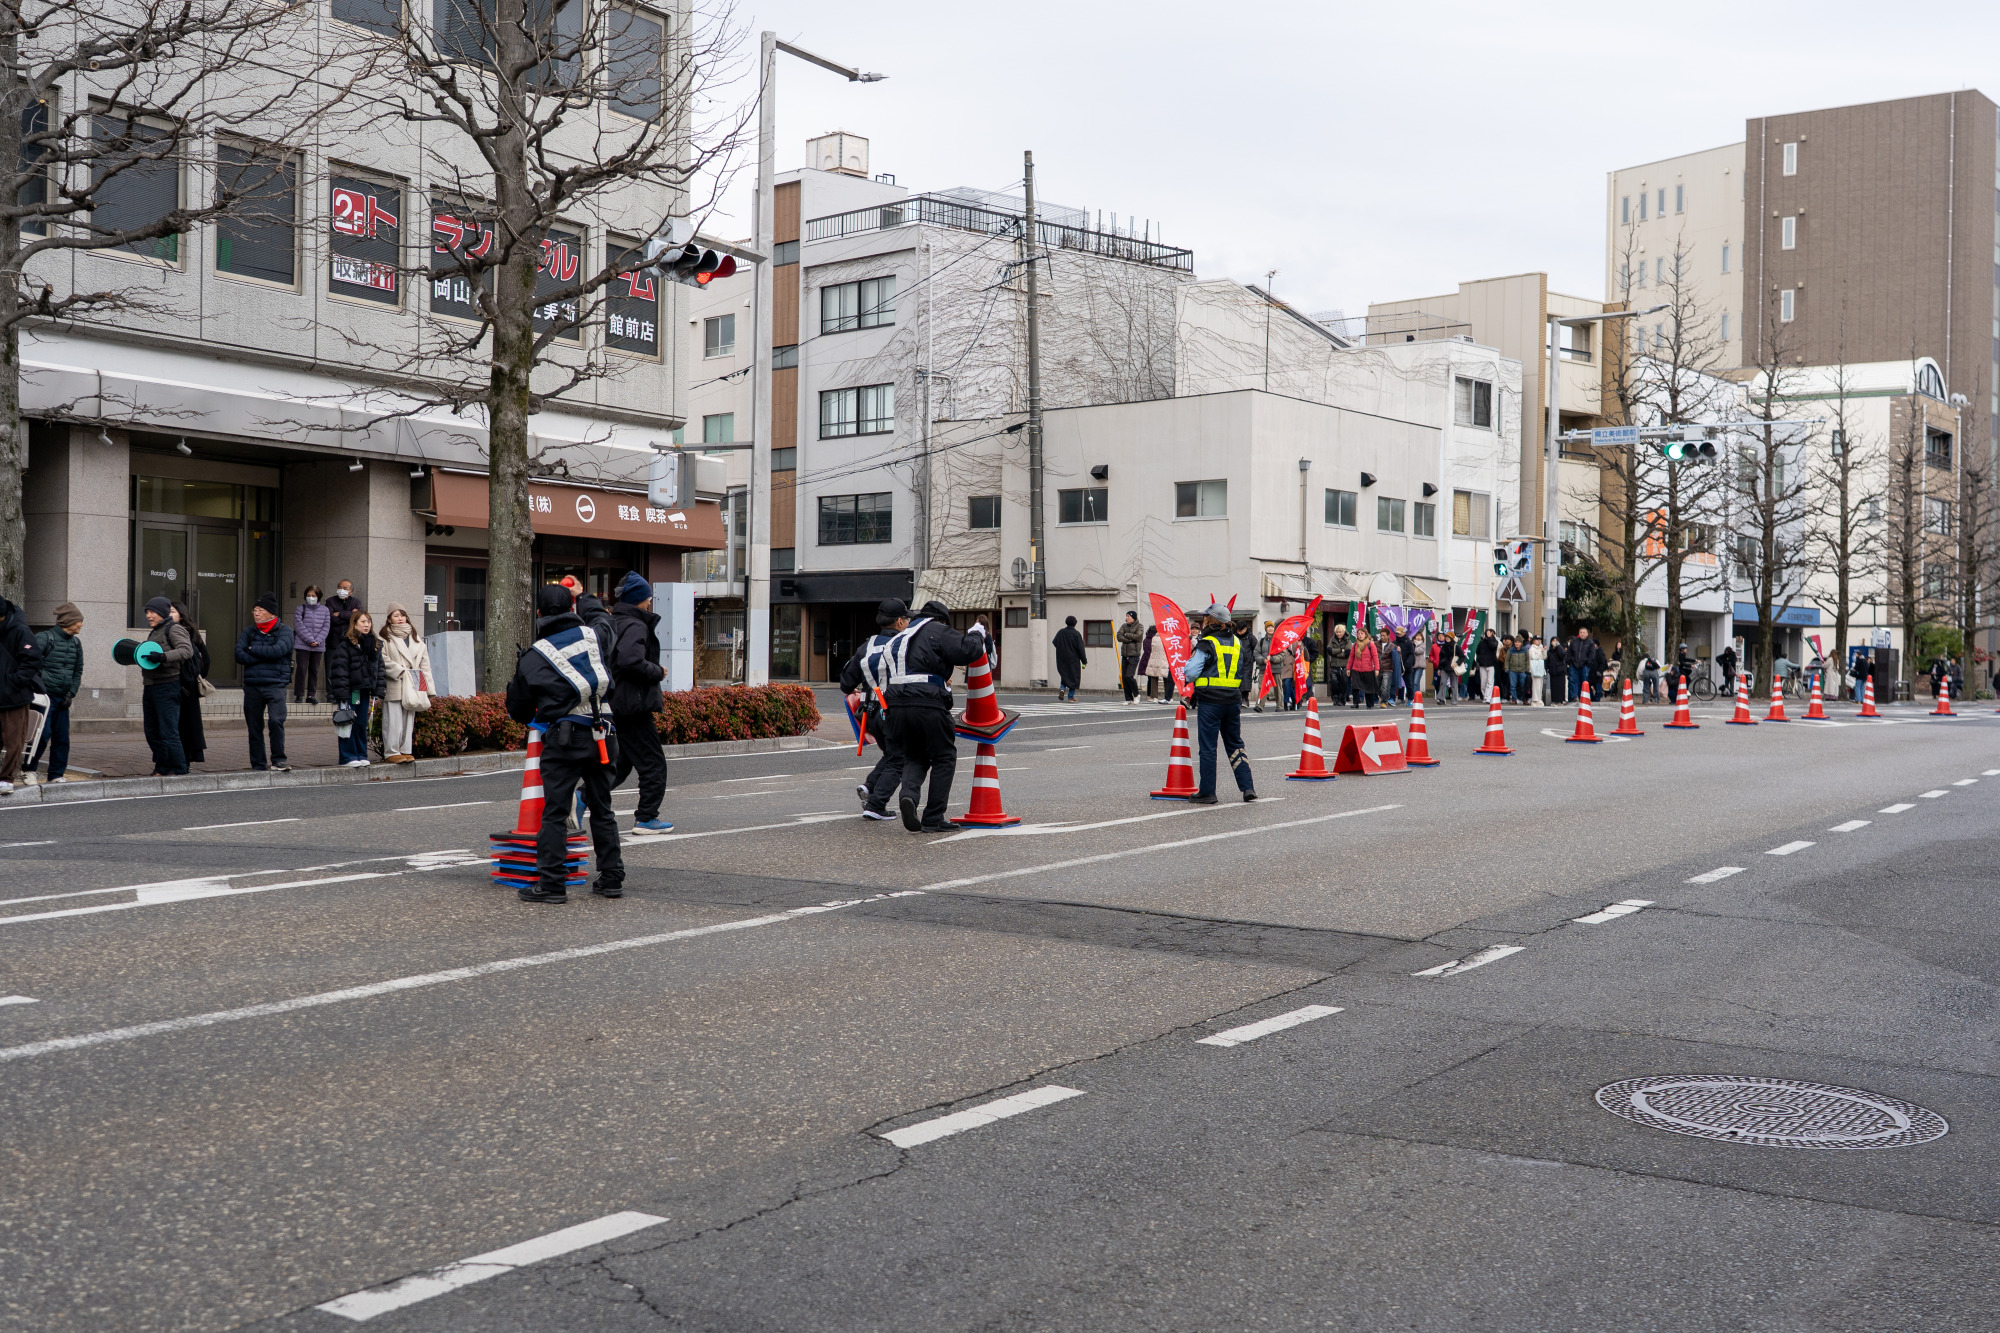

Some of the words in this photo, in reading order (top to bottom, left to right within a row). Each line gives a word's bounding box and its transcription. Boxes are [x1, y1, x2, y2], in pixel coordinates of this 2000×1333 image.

[335, 193, 364, 231] 2F
[609, 313, 655, 343] 館前店
[617, 505, 641, 522] 軽食
[150, 569, 167, 578] Rotary
